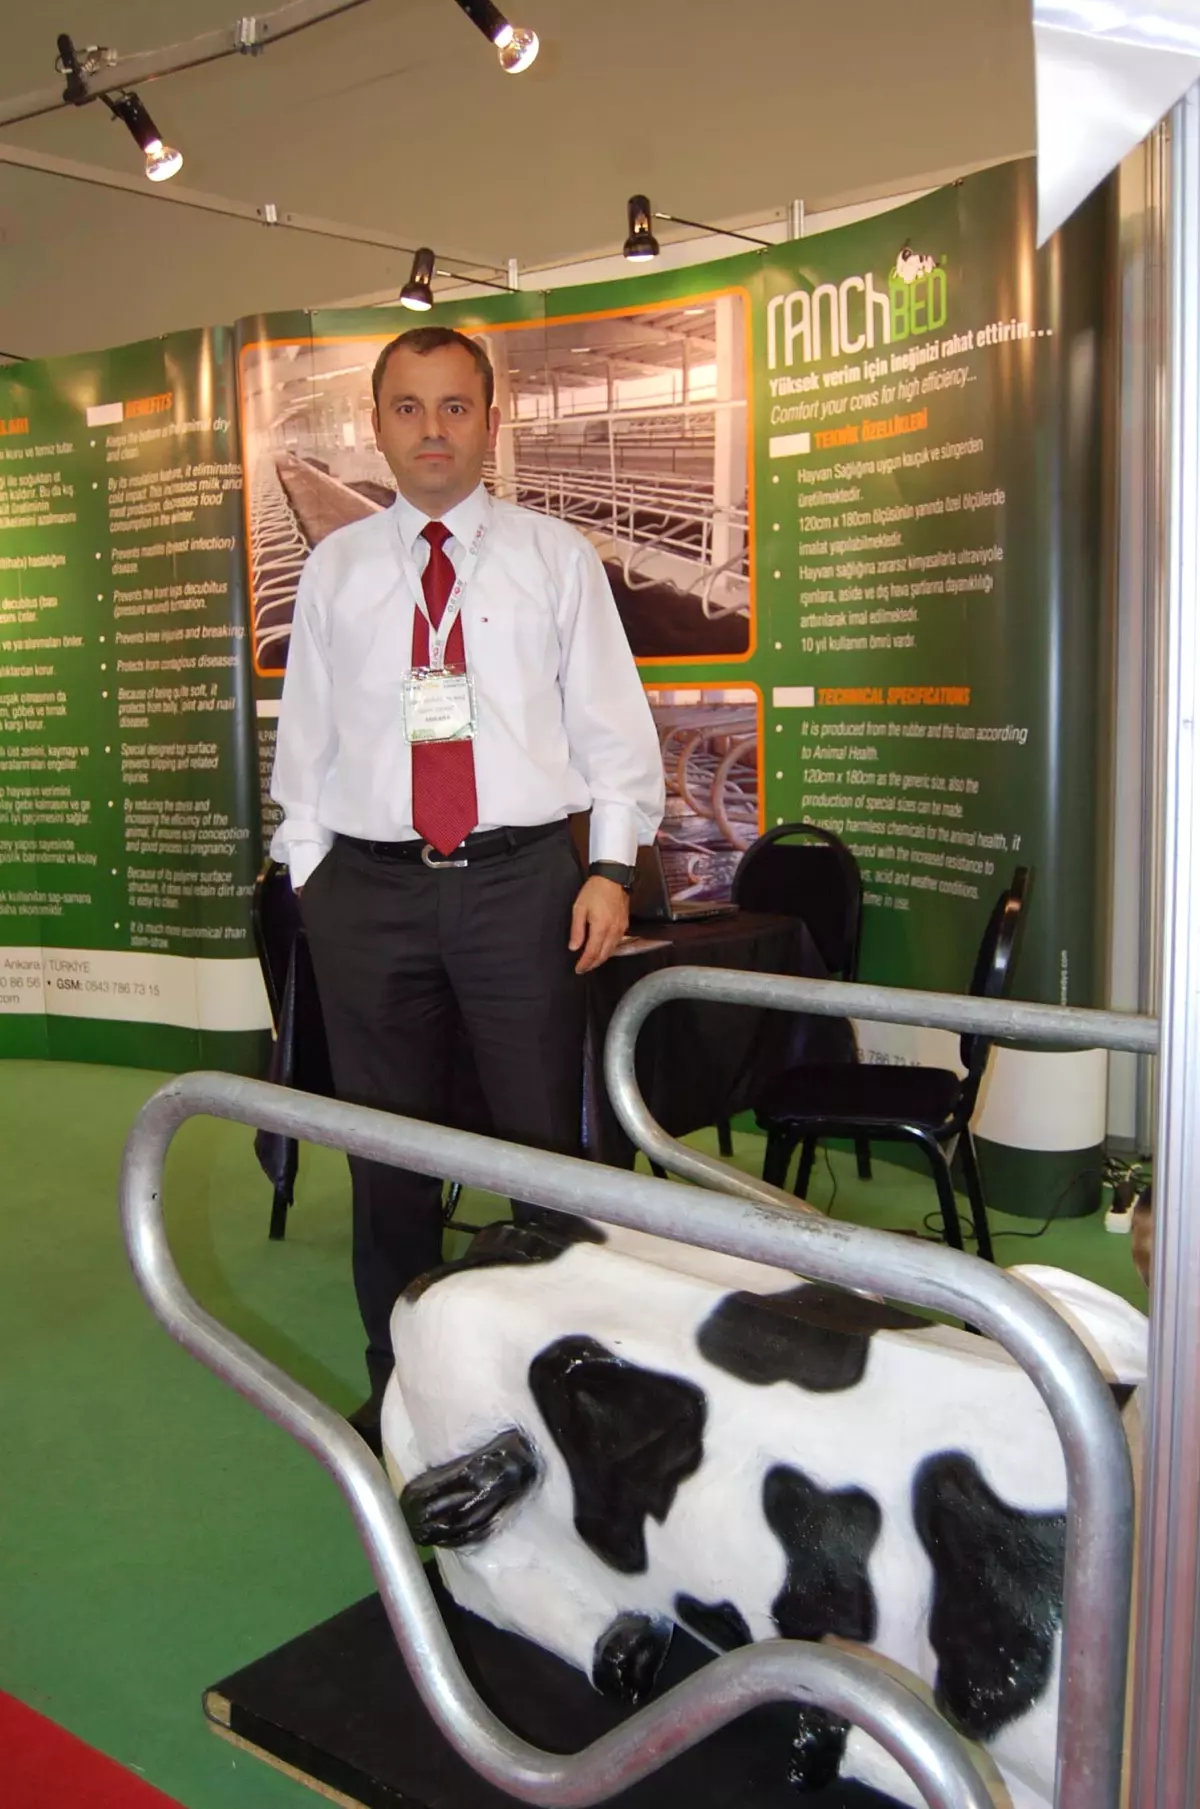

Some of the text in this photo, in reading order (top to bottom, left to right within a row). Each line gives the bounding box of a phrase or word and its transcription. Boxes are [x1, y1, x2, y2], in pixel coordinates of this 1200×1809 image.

[769, 372, 820, 397] Yüksek
[822, 364, 861, 388] verim
[863, 357, 888, 384] için
[890, 340, 939, 373] ineğinizi
[941, 329, 974, 358] rahat
[770, 400, 820, 425] Comfort
[820, 397, 848, 421] your
[850, 390, 879, 412] cows
[881, 385, 896, 404] for
[897, 378, 920, 403] high
[213, 417, 231, 434] dry
[192, 462, 242, 477] eliminates
[797, 468, 832, 485] Hayvan
[877, 456, 902, 475] uygun
[199, 477, 220, 490] milk
[222, 476, 242, 490] and
[199, 493, 223, 506] food
[799, 515, 832, 532] 120cm
[832, 517, 839, 529] x
[190, 536, 236, 551] infection)
[799, 565, 834, 582] Hayvan
[802, 637, 814, 652] 10
[810, 721, 820, 737] is
[820, 720, 865, 738] produced
[976, 724, 1028, 745] according
[813, 744, 847, 760] Animal
[801, 792, 853, 809] production
[197, 827, 250, 841] conception
[217, 884, 235, 897] dirt
[4, 958, 91, 974] Ankara TÜRKİYE
[112, 981, 130, 995] 786
[133, 983, 146, 996] 73
[149, 985, 160, 997] 15
